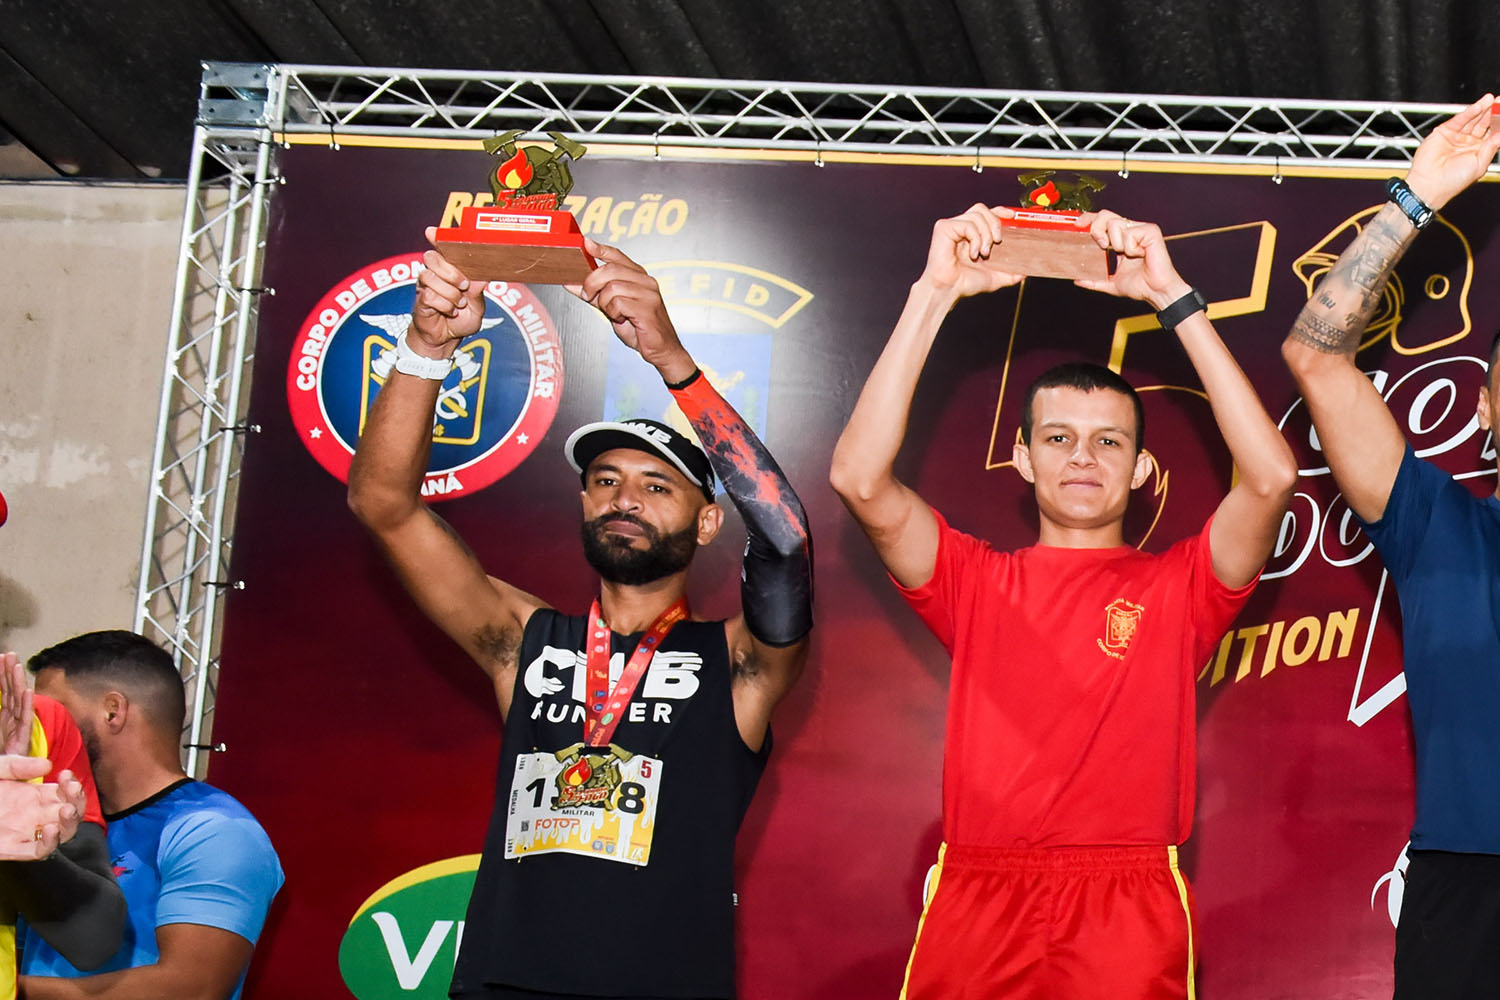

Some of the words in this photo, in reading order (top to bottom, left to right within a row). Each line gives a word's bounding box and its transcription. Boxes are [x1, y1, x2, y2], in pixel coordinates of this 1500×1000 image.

[439, 191, 689, 243] RZAÇÃO
[658, 273, 771, 308] EFID
[296, 308, 340, 391] CORPO
[335, 278, 372, 311] DE
[372, 260, 523, 308] BOMOS
[516, 303, 555, 399] MILITAR
[420, 472, 464, 496] ANÁ
[1197, 607, 1360, 687] ITION
[531, 701, 673, 724] RUNER
[640, 760, 652, 779] 5
[526, 778, 647, 814] 18
[535, 818, 581, 831] FOTOP
[561, 809, 595, 817] MILITAR
